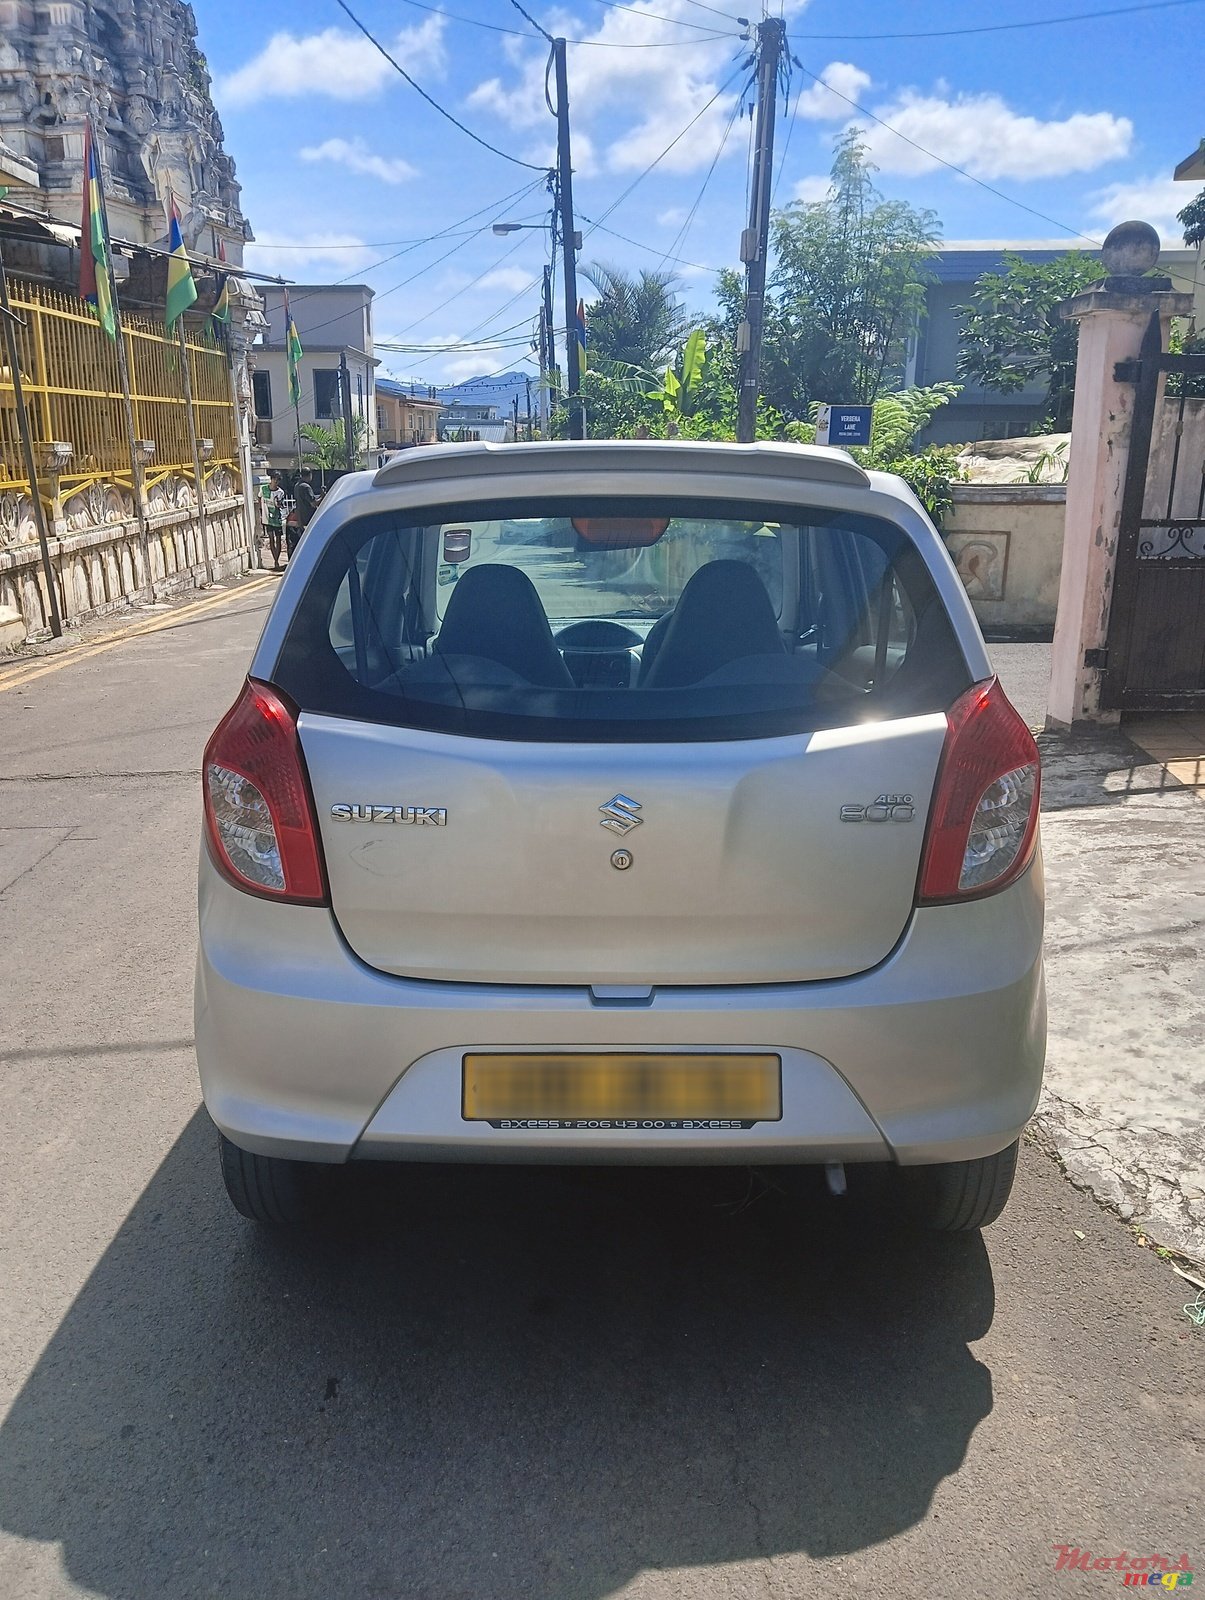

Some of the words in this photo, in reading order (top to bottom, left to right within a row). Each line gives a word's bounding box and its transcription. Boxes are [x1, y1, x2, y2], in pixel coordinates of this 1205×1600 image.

[874, 794, 914, 804] ALTO
[330, 803, 447, 826] SUZUKI
[840, 804, 916, 822] 800
[500, 1120, 560, 1129] axess
[577, 1120, 611, 1129] 206
[615, 1120, 638, 1129] 43
[642, 1120, 665, 1129] 00
[682, 1120, 742, 1129] axess
